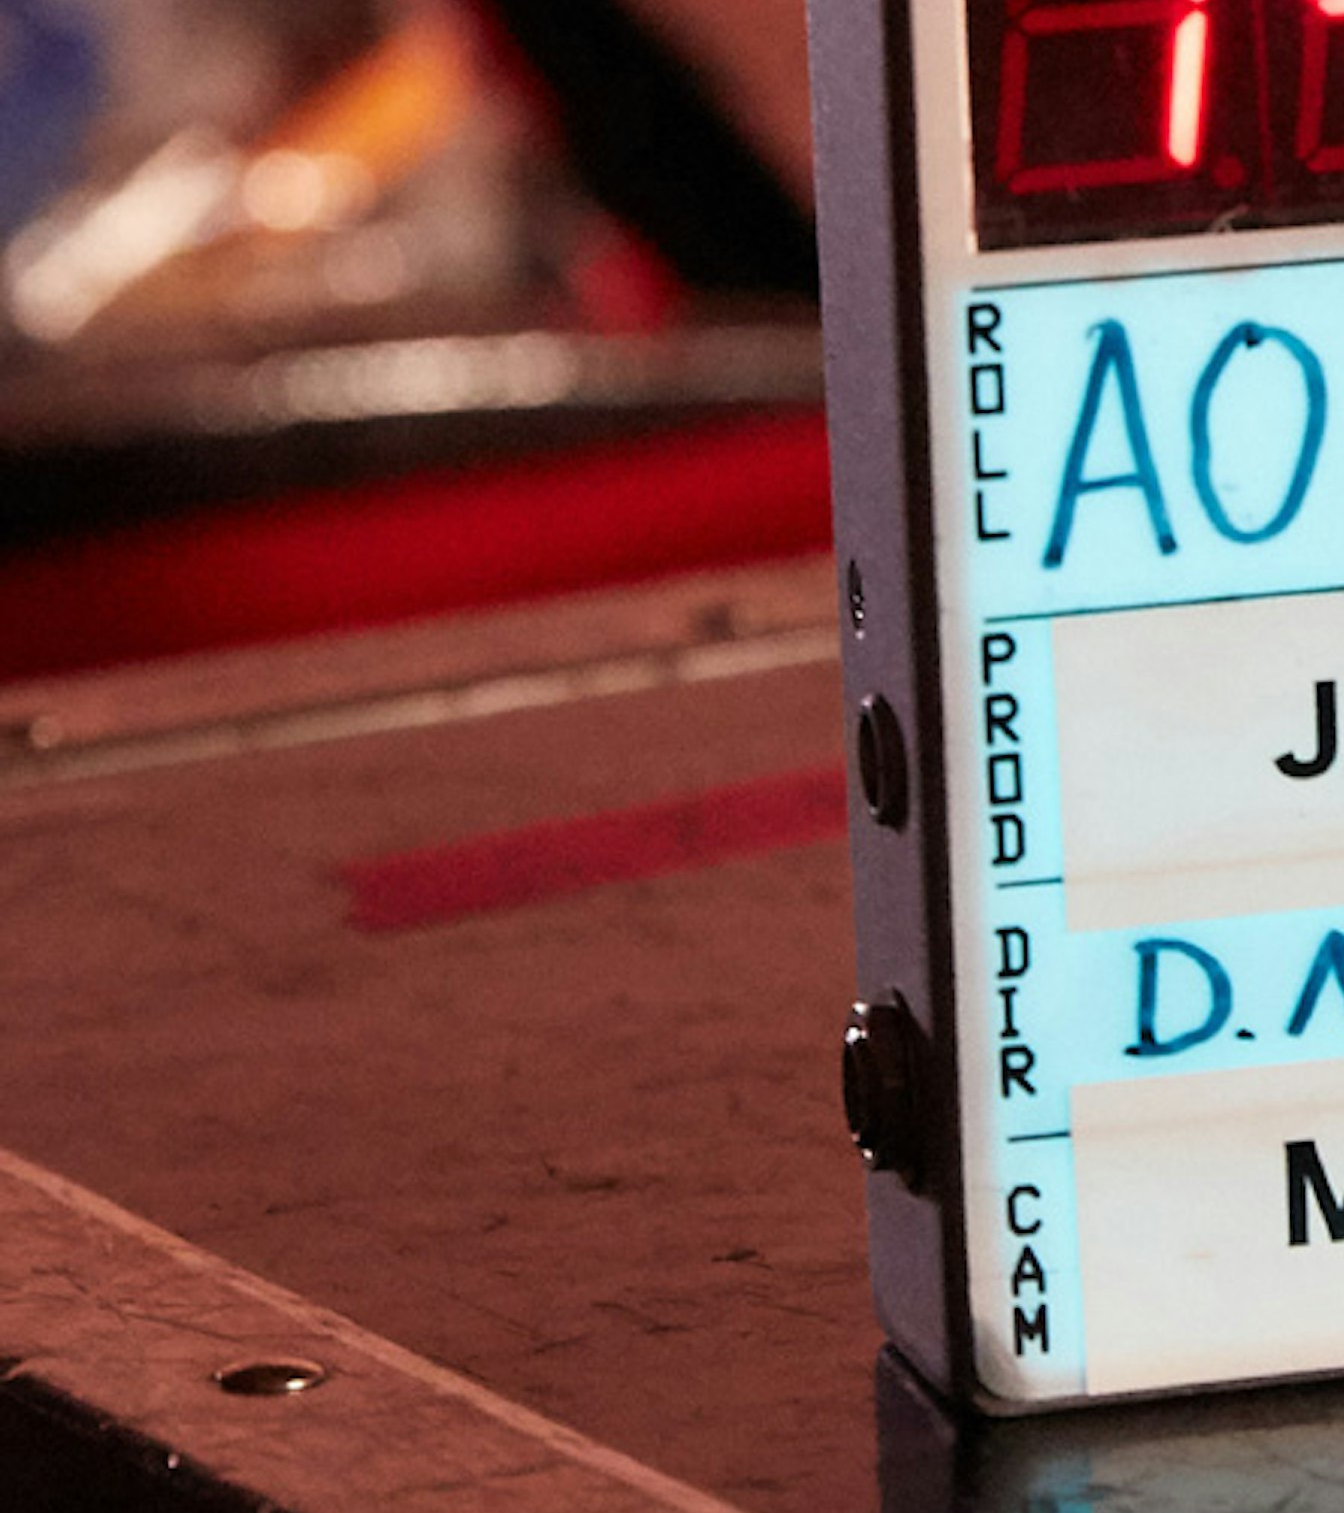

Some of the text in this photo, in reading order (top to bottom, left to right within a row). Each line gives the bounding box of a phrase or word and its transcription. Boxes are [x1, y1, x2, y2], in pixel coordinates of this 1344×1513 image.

[967, 303, 1010, 541] ROLL
[981, 633, 1025, 866] PROD
[995, 926, 1036, 1098] DIR
[1123, 936, 1256, 1059] D.
[1006, 1185, 1050, 1357] CAM
